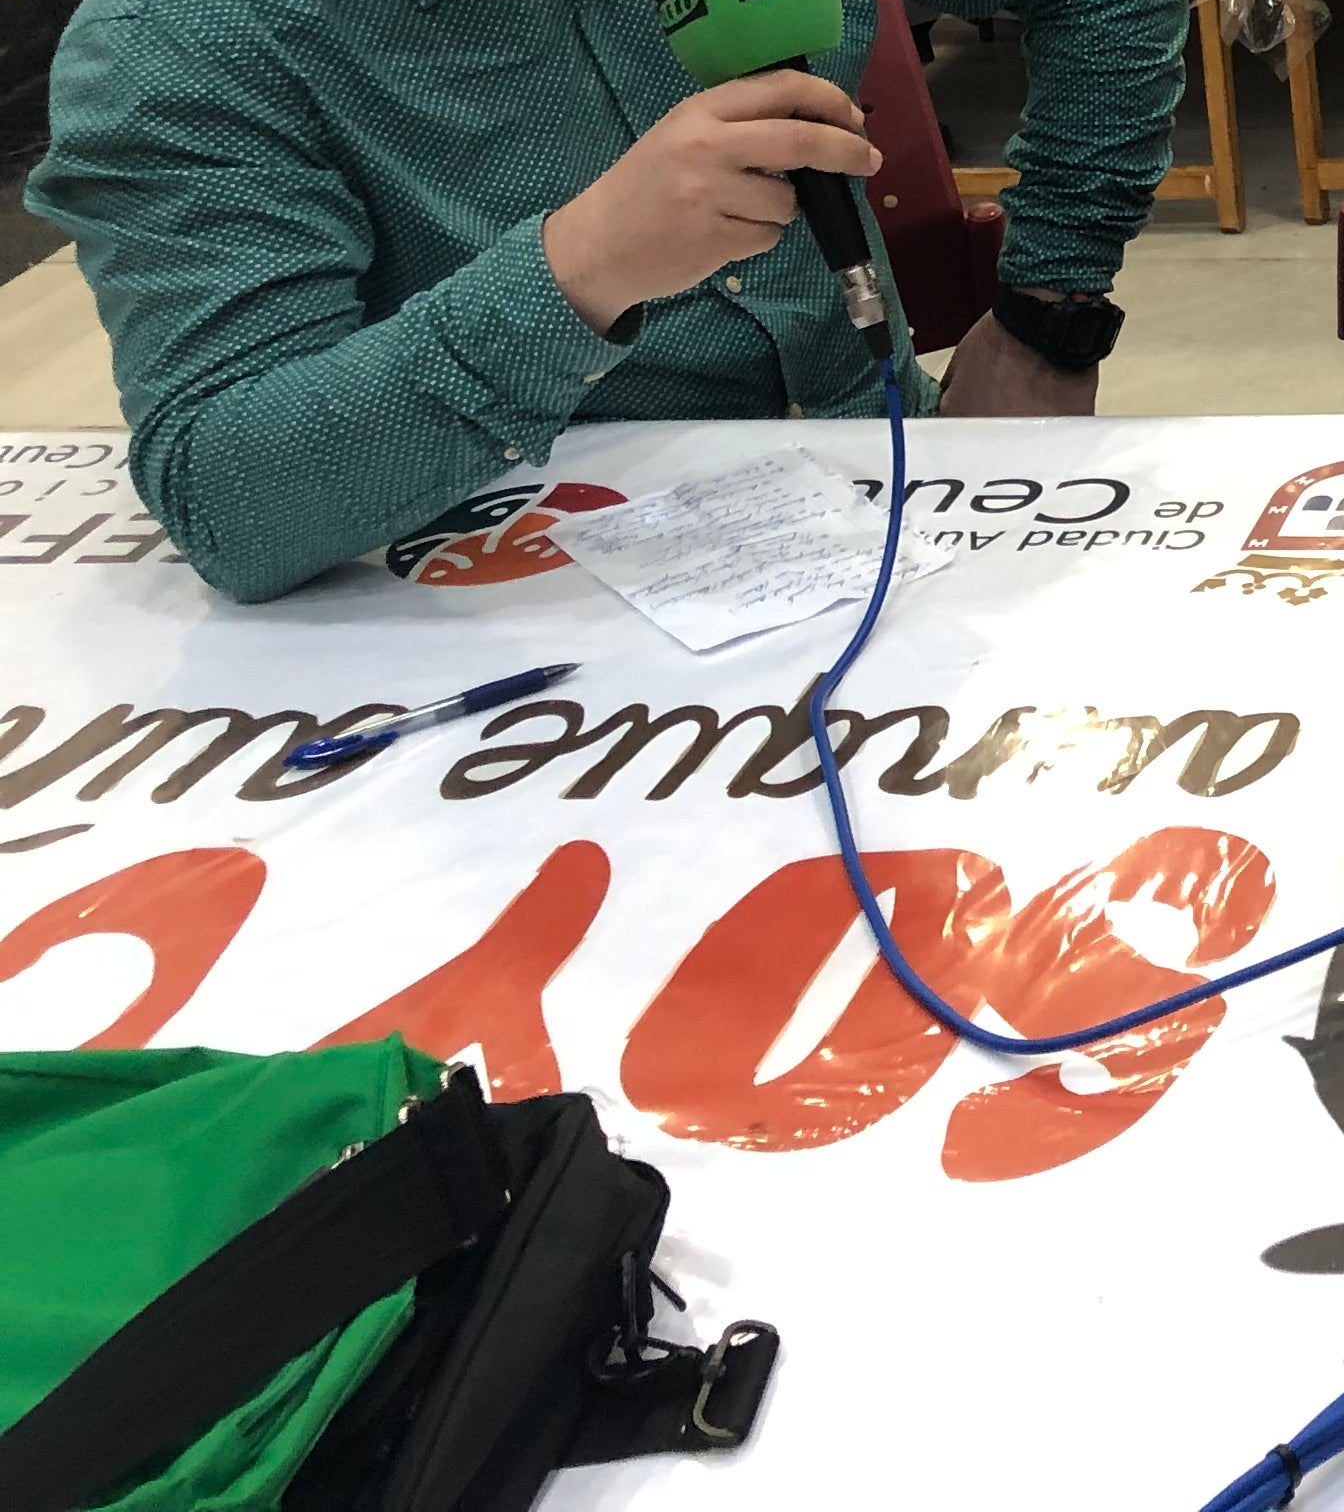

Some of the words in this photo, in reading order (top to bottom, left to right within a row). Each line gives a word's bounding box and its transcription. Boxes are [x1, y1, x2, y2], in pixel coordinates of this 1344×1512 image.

[1016, 529, 1206, 552] Ciudad
[1153, 500, 1225, 524] de
[440, 672, 1302, 800] aunque
[304, 824, 1277, 1184] SOY
